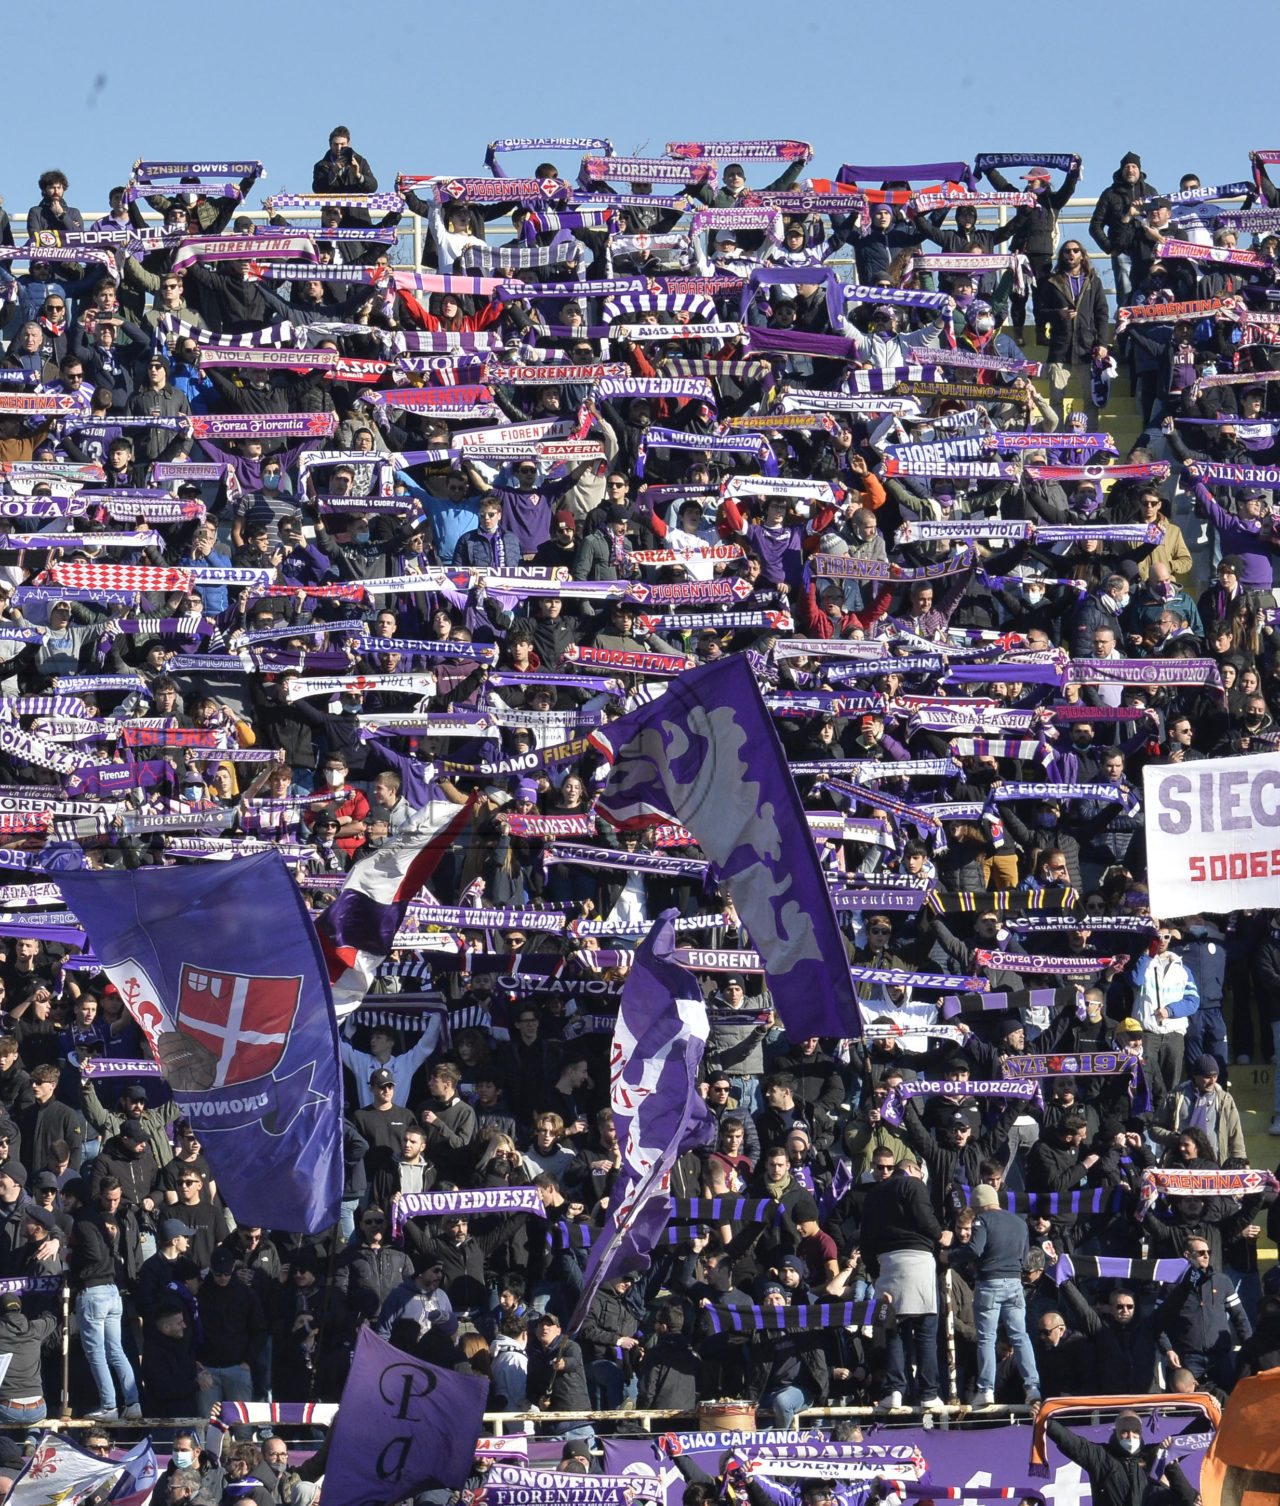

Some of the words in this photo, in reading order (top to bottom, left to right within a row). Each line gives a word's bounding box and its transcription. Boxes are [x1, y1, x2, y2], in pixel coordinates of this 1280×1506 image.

[704, 144, 777, 157] FIORENTINA
[193, 163, 229, 172] SIAMO
[979, 155, 1001, 168] ACF
[1004, 153, 1070, 167] FIORENTINA
[147, 165, 189, 176] FIRENZE
[231, 164, 252, 173] NOI
[608, 163, 691, 178] FIORENTINA
[466, 181, 539, 196] FIORENTINA
[1180, 183, 1248, 201] FIORENTINA
[588, 196, 618, 204] JUVE
[762, 196, 804, 207] Forza
[809, 196, 864, 210] Fiorentina
[711, 213, 769, 224] FIORENTINA
[338, 229, 375, 239] VIOLA
[30, 247, 76, 259] FIORENTINA
[205, 239, 291, 253] FIORENTINA
[273, 264, 363, 281] FIORENTINA
[504, 283, 536, 295] VIA
[543, 282, 571, 294] LA
[573, 279, 643, 293] MERDA
[1133, 298, 1222, 317] FIORENTINA
[697, 322, 743, 334] VIOLA
[216, 351, 252, 361] VIOLA
[262, 351, 319, 362] FOREVER
[508, 365, 604, 378] FIORENTINA
[798, 400, 904, 411] FIORENTINA
[218, 419, 257, 432] Forza
[260, 418, 304, 430] Florentia
[463, 431, 487, 444] ALE
[501, 424, 564, 438] FIORENTINA
[672, 434, 711, 445] NUOVO
[1003, 435, 1099, 448] FIORENTINA
[548, 445, 601, 453] BAYERN
[898, 461, 999, 477] FIORENTINA
[816, 557, 890, 577] FIRENZE
[199, 568, 270, 584] MERDA
[651, 582, 731, 598] FIORENTINA
[664, 611, 763, 628] FIORENTINA
[363, 637, 474, 657] FIORENTINA
[581, 648, 684, 671] FIORENTINA
[827, 664, 854, 676] ACF
[857, 658, 940, 673] FIORENTINA
[389, 718, 467, 730] FIORENTINA
[99, 769, 130, 781] Firenze
[1020, 783, 1119, 797] FIORENTINA
[144, 813, 214, 826] FIORENTINA
[465, 909, 504, 926] VANTO
[508, 912, 518, 926] E
[1006, 918, 1040, 928] ACF
[992, 952, 1029, 967] Forza
[1033, 953, 1097, 967] Fiorentina
[852, 968, 962, 988] FIRENZE
[1251, 1068, 1270, 1085] 10
[680, 1434, 718, 1449] CIAO
[720, 1431, 799, 1448] CAPITANO
[495, 1488, 619, 1505] FIORENTINA
